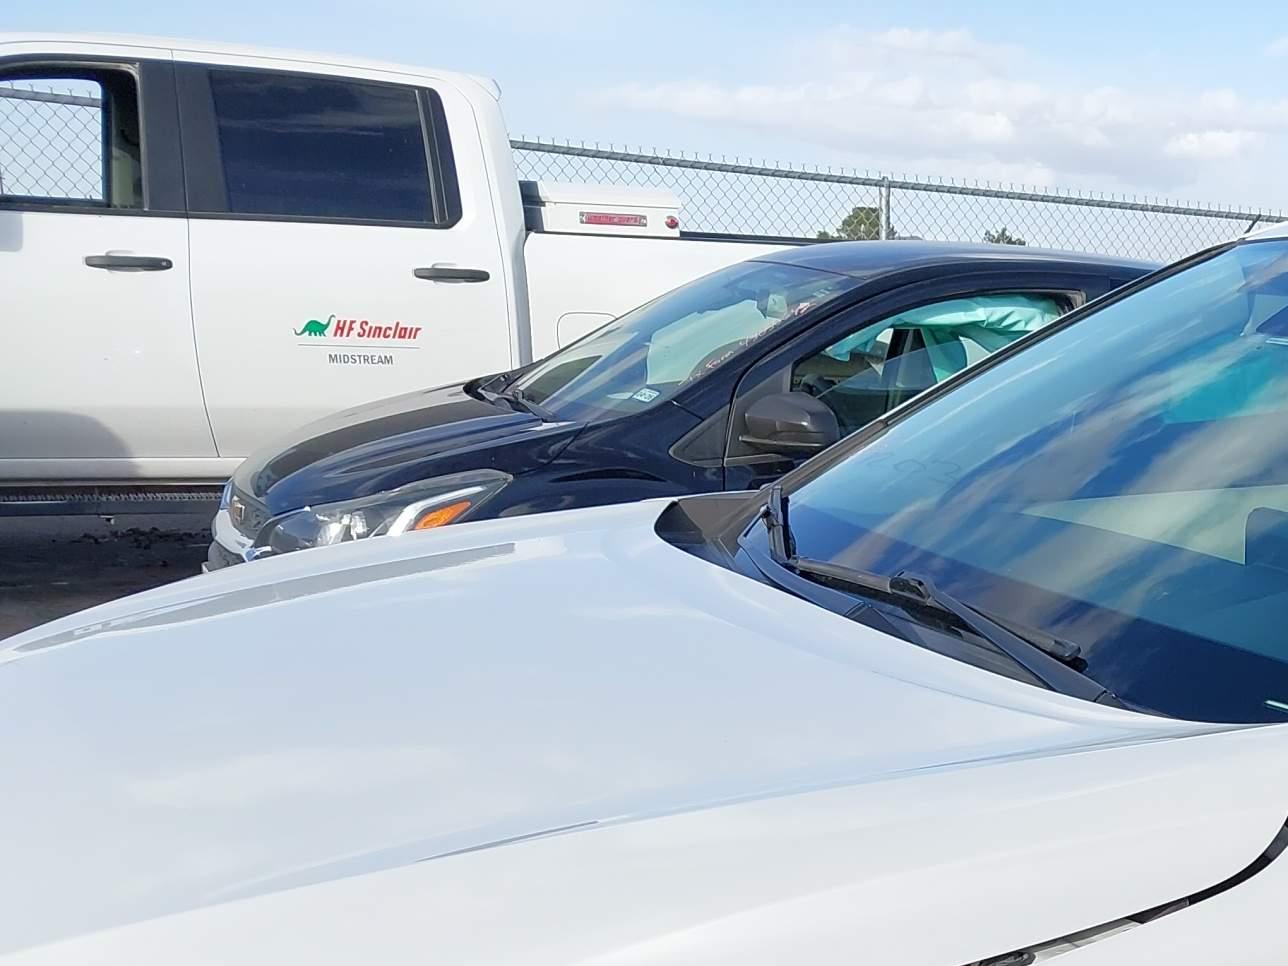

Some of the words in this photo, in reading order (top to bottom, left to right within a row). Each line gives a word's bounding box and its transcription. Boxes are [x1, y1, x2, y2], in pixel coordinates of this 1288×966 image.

[333, 319, 356, 338] HF
[357, 320, 421, 339] Sinclair
[328, 353, 394, 365] MIDSTREAM
